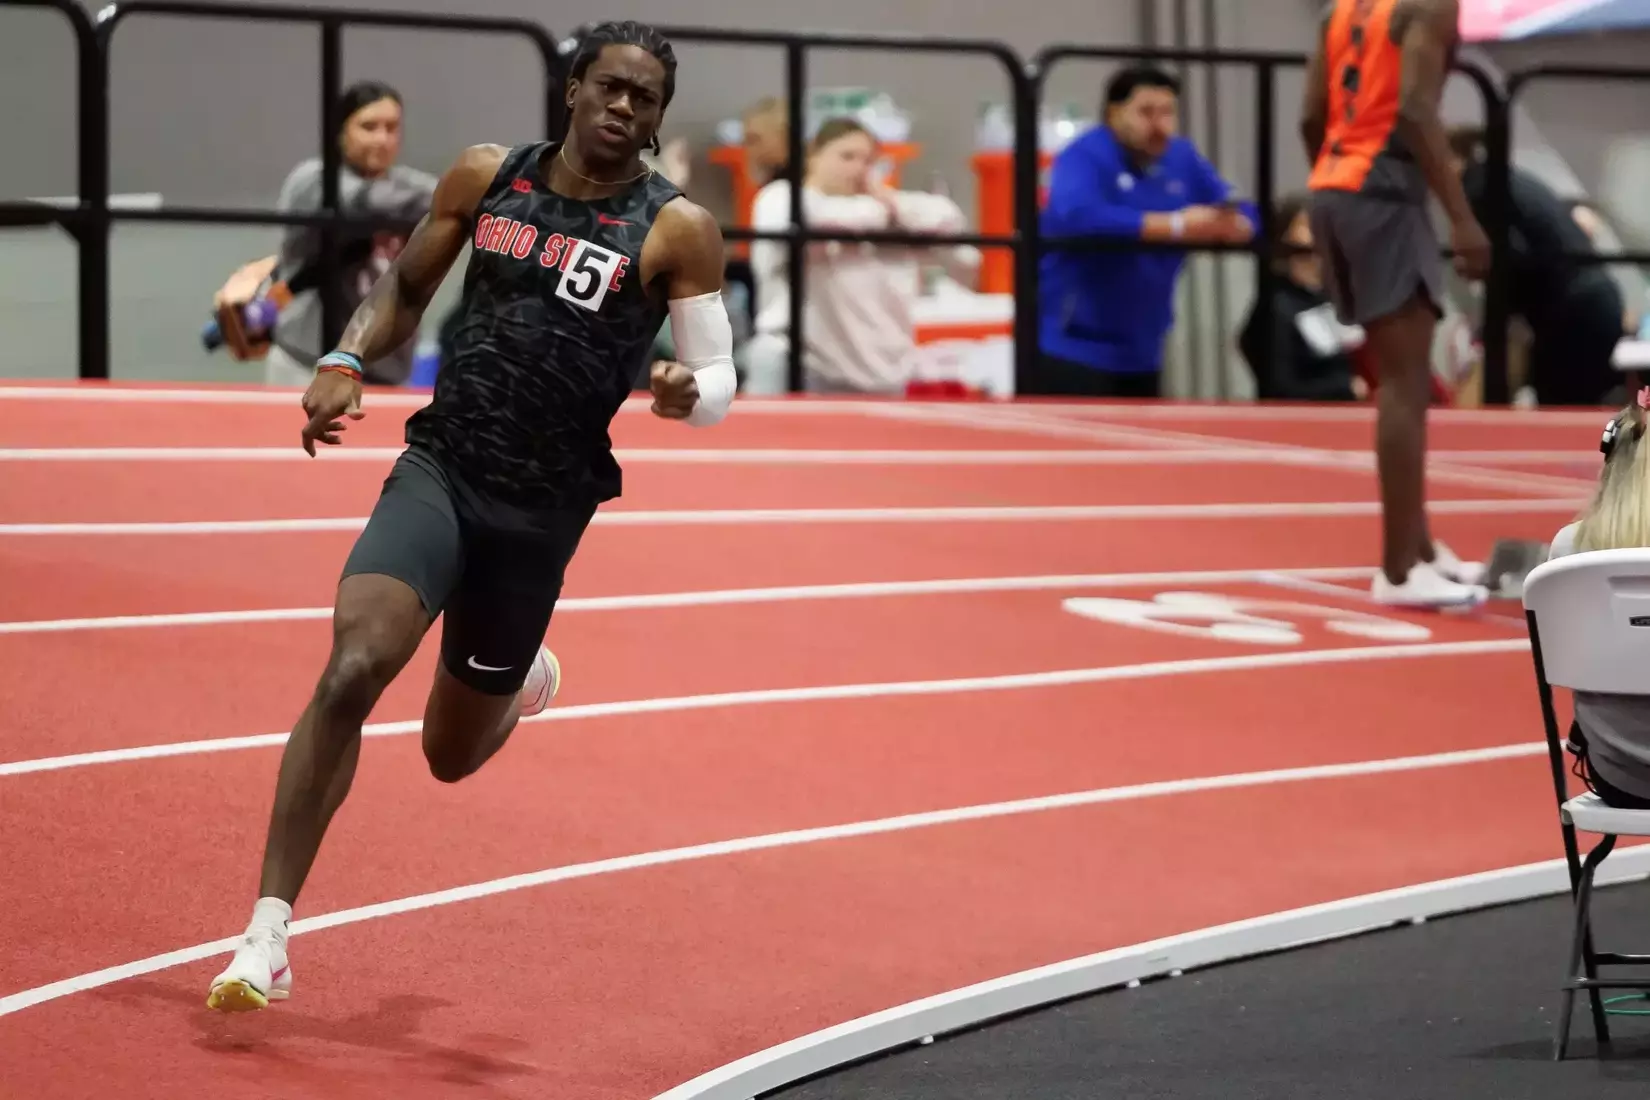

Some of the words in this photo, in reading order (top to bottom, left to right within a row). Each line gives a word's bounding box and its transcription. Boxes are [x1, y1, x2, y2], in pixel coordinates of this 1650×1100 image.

[475, 213, 538, 259] OHIO
[540, 233, 631, 292] STE
[566, 246, 610, 301] 5
